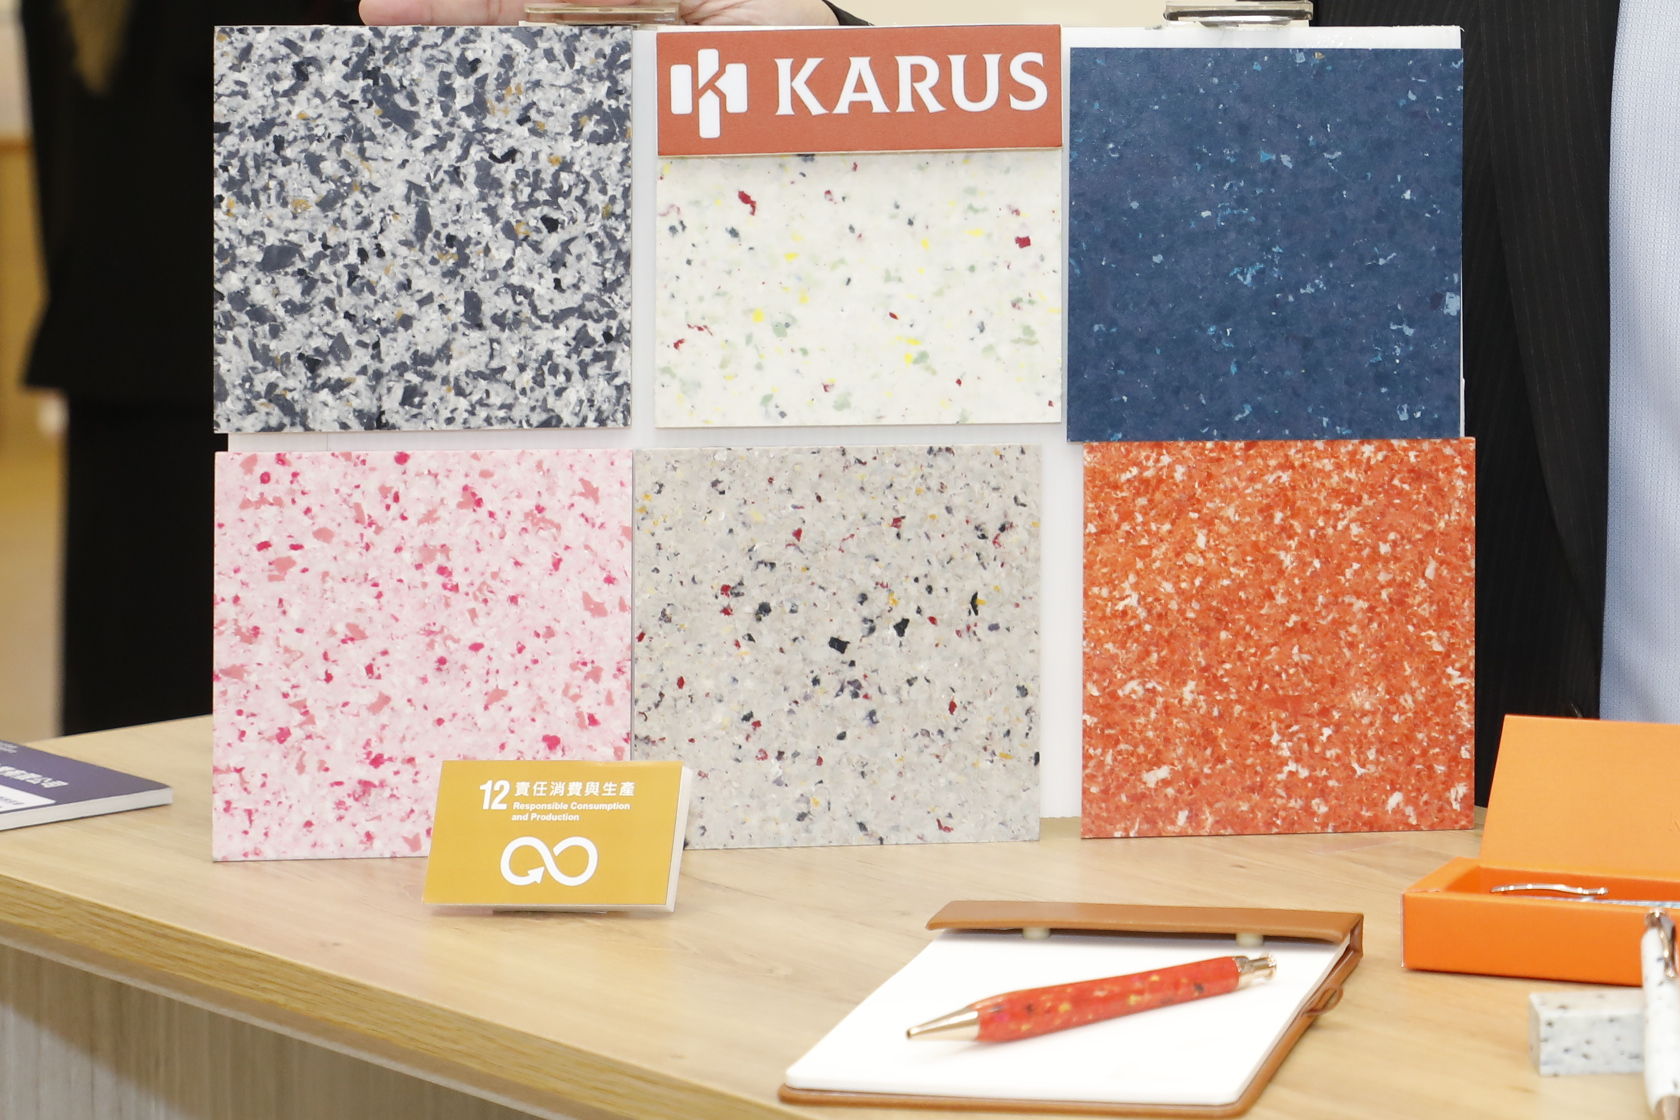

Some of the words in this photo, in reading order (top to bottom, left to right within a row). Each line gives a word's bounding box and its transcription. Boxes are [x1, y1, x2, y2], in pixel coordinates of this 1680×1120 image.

[774, 52, 1048, 116] KARUS
[480, 780, 510, 810] 12
[514, 781, 635, 797] 責任消費與生產
[513, 801, 568, 811] Responsible
[570, 801, 631, 811] Consumption
[512, 812, 528, 821] and
[530, 812, 580, 821] Production
